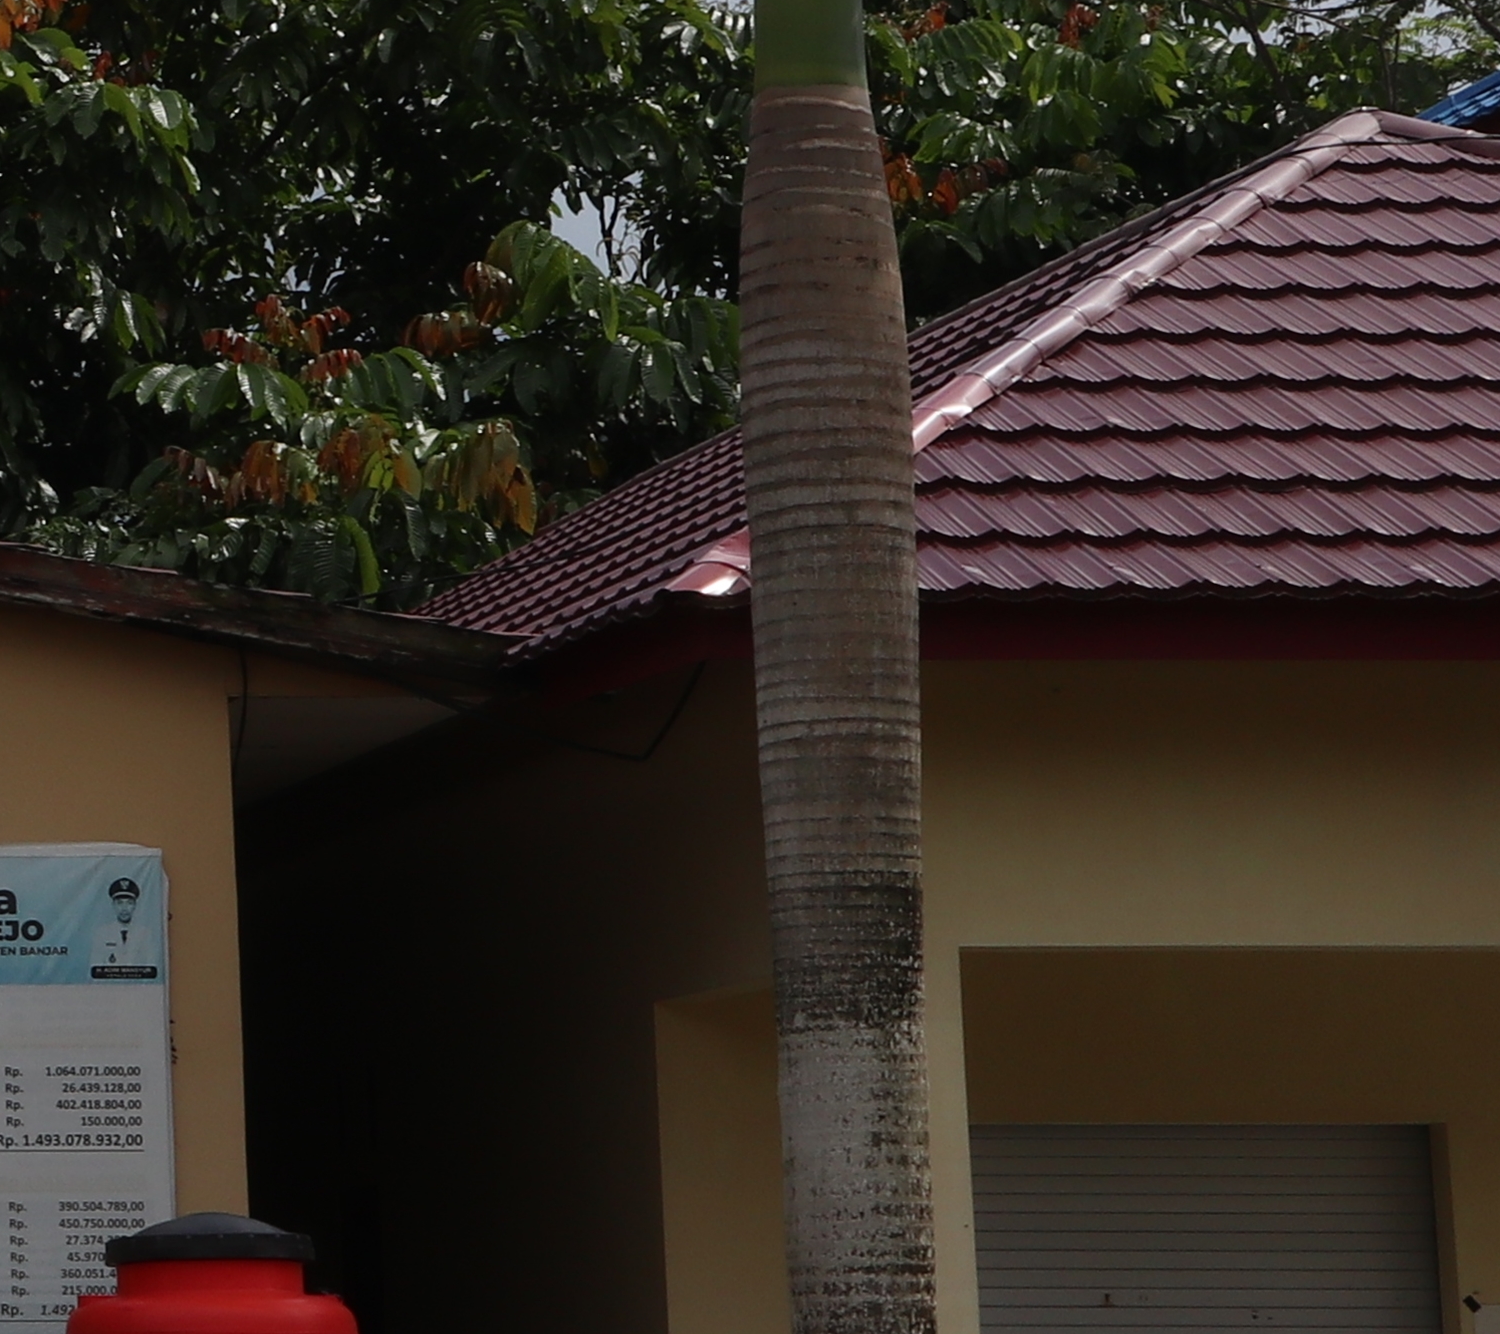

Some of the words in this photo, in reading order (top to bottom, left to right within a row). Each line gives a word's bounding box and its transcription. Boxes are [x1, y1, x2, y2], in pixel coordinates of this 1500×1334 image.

[19, 946, 68, 957] BANJAR
[5, 1066, 23, 1080] Rp.
[45, 1066, 141, 1077] 1.064.071.000,00
[5, 1083, 24, 1096] Rp.
[62, 1083, 142, 1095] 26.439.128,00
[6, 1100, 24, 1113] Rp.
[56, 1100, 142, 1111] 402.418.804,00
[6, 1117, 24, 1130] Rp.
[81, 1117, 142, 1128] 150.000,00
[22, 1134, 143, 1148] 1.493.078.932,00
[8, 1202, 28, 1214] Rp.
[58, 1201, 144, 1212] 390.504.789,00
